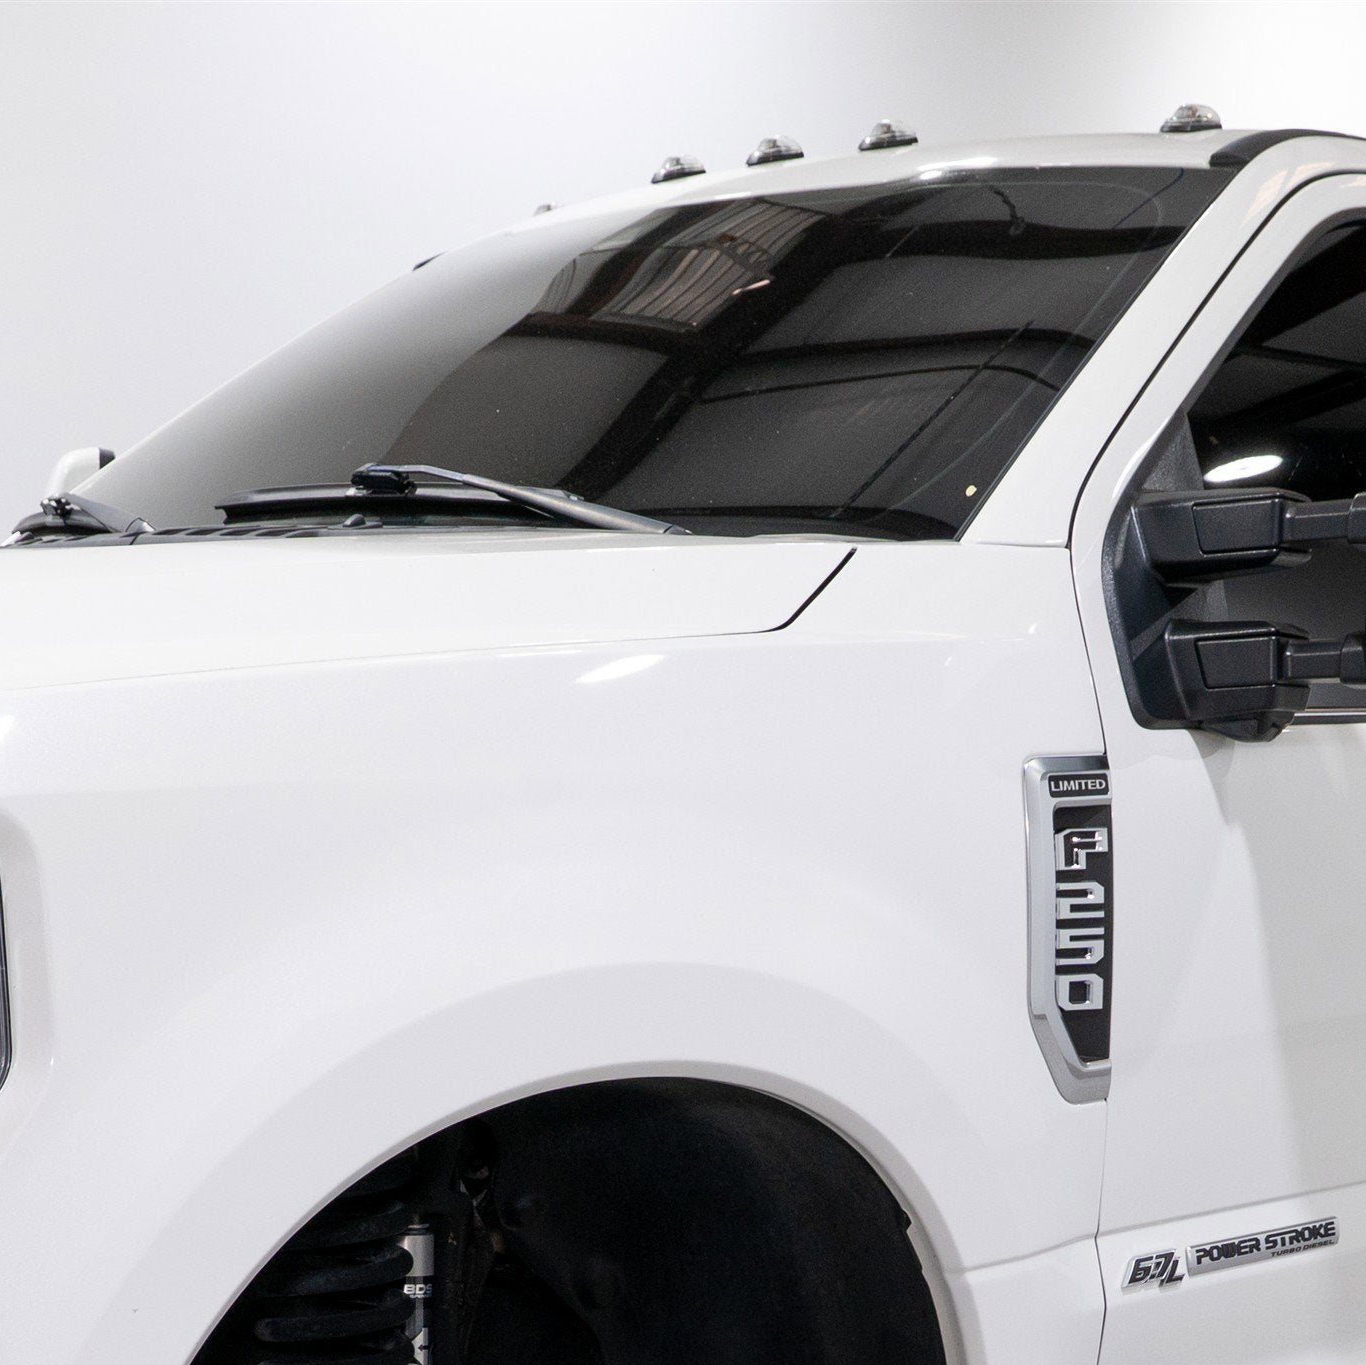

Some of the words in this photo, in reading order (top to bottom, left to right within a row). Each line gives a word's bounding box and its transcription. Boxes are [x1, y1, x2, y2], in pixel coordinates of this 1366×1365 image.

[1050, 779, 1107, 792] LIMITED
[1055, 826, 1109, 1011] F250
[1195, 1237, 1261, 1266] POWER
[1264, 1221, 1336, 1250] STROKE
[1271, 1246, 1302, 1258] TURBO
[1303, 1239, 1335, 1250] DIESEL
[403, 1283, 433, 1295] BDS
